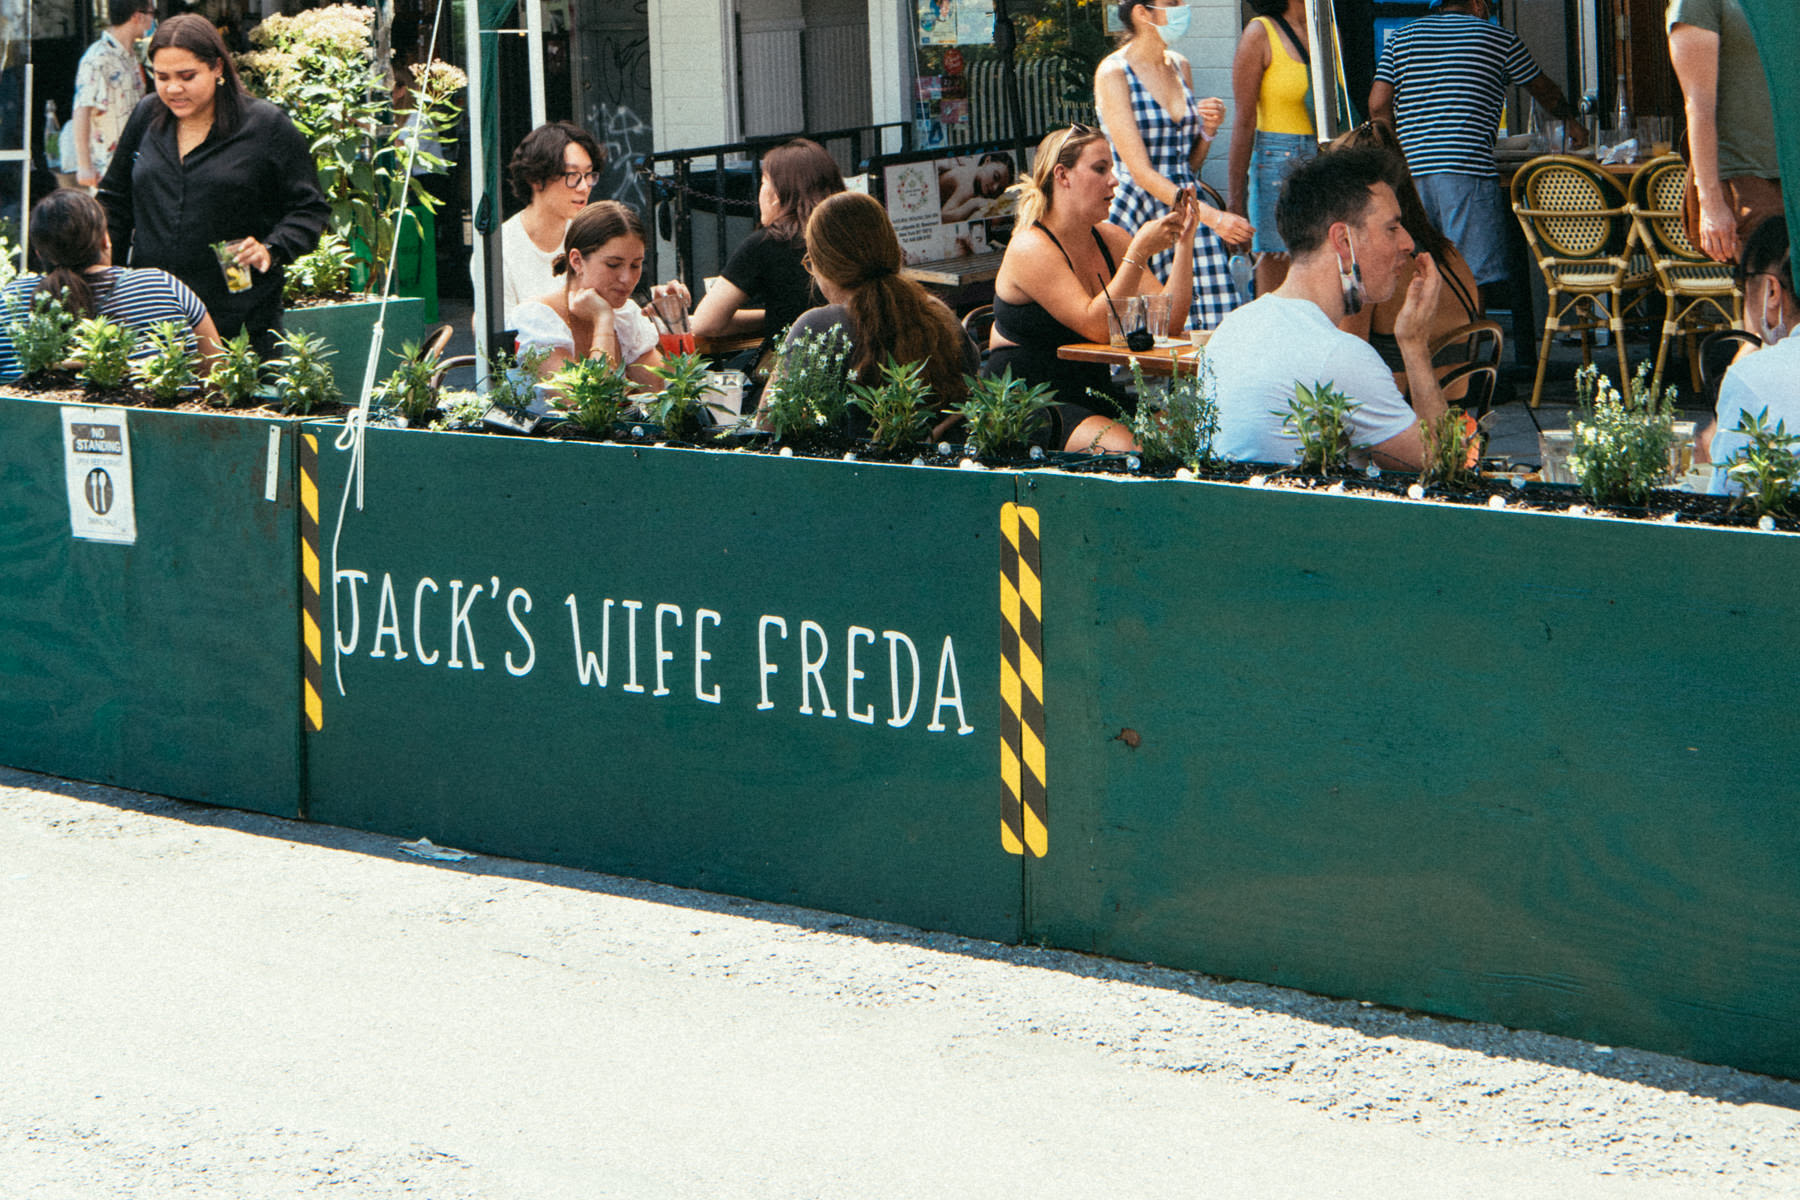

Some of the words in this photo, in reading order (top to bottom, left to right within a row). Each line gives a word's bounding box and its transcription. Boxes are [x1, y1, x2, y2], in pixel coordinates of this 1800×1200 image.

[91, 427, 105, 439] NO
[75, 439, 121, 452] STANDING
[335, 569, 536, 677] JACK'S
[565, 593, 721, 704] WIFE
[756, 614, 974, 736] FREDA
